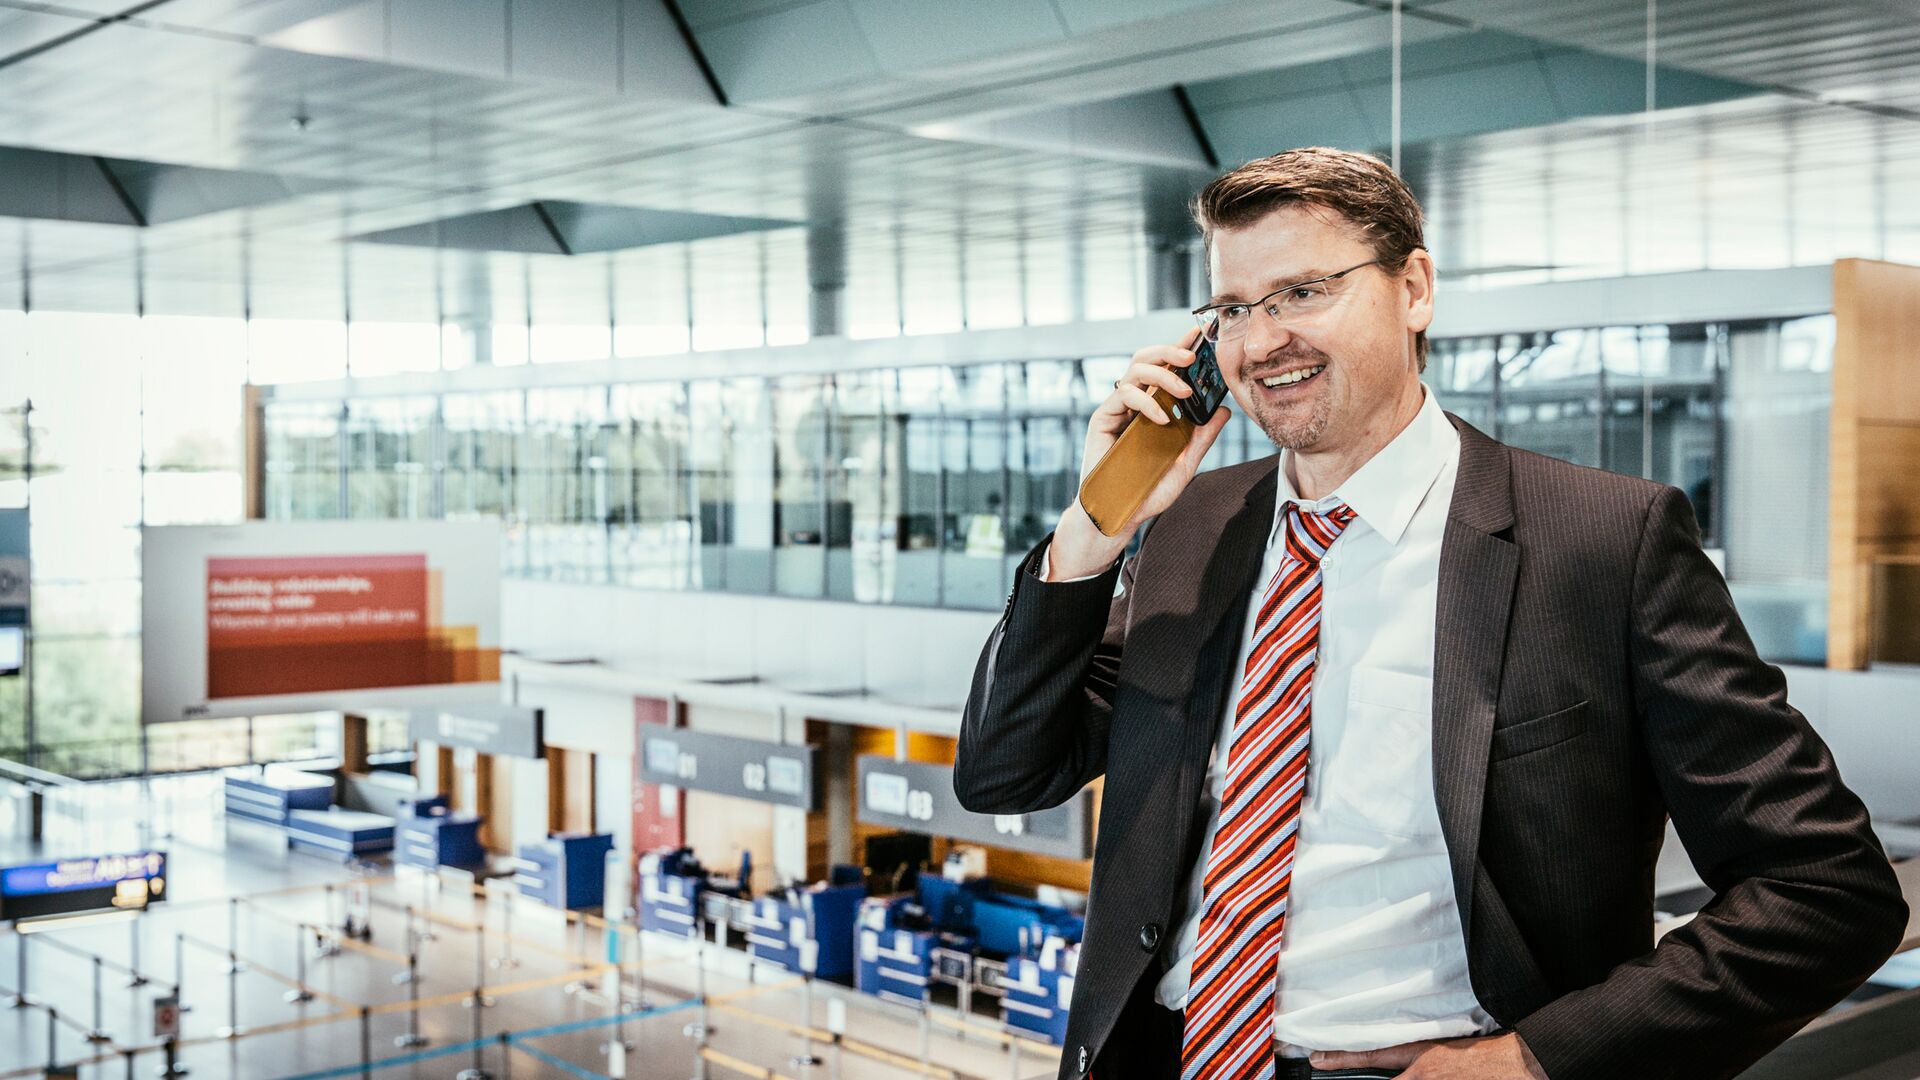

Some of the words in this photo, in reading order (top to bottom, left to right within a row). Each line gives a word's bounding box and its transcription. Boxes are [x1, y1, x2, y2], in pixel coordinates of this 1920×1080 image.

[211, 578, 273, 597] Building
[211, 597, 272, 612] creating
[275, 595, 315, 609] value
[678, 752, 697, 780] 01
[743, 763, 766, 791] 02
[908, 789, 933, 821] 03
